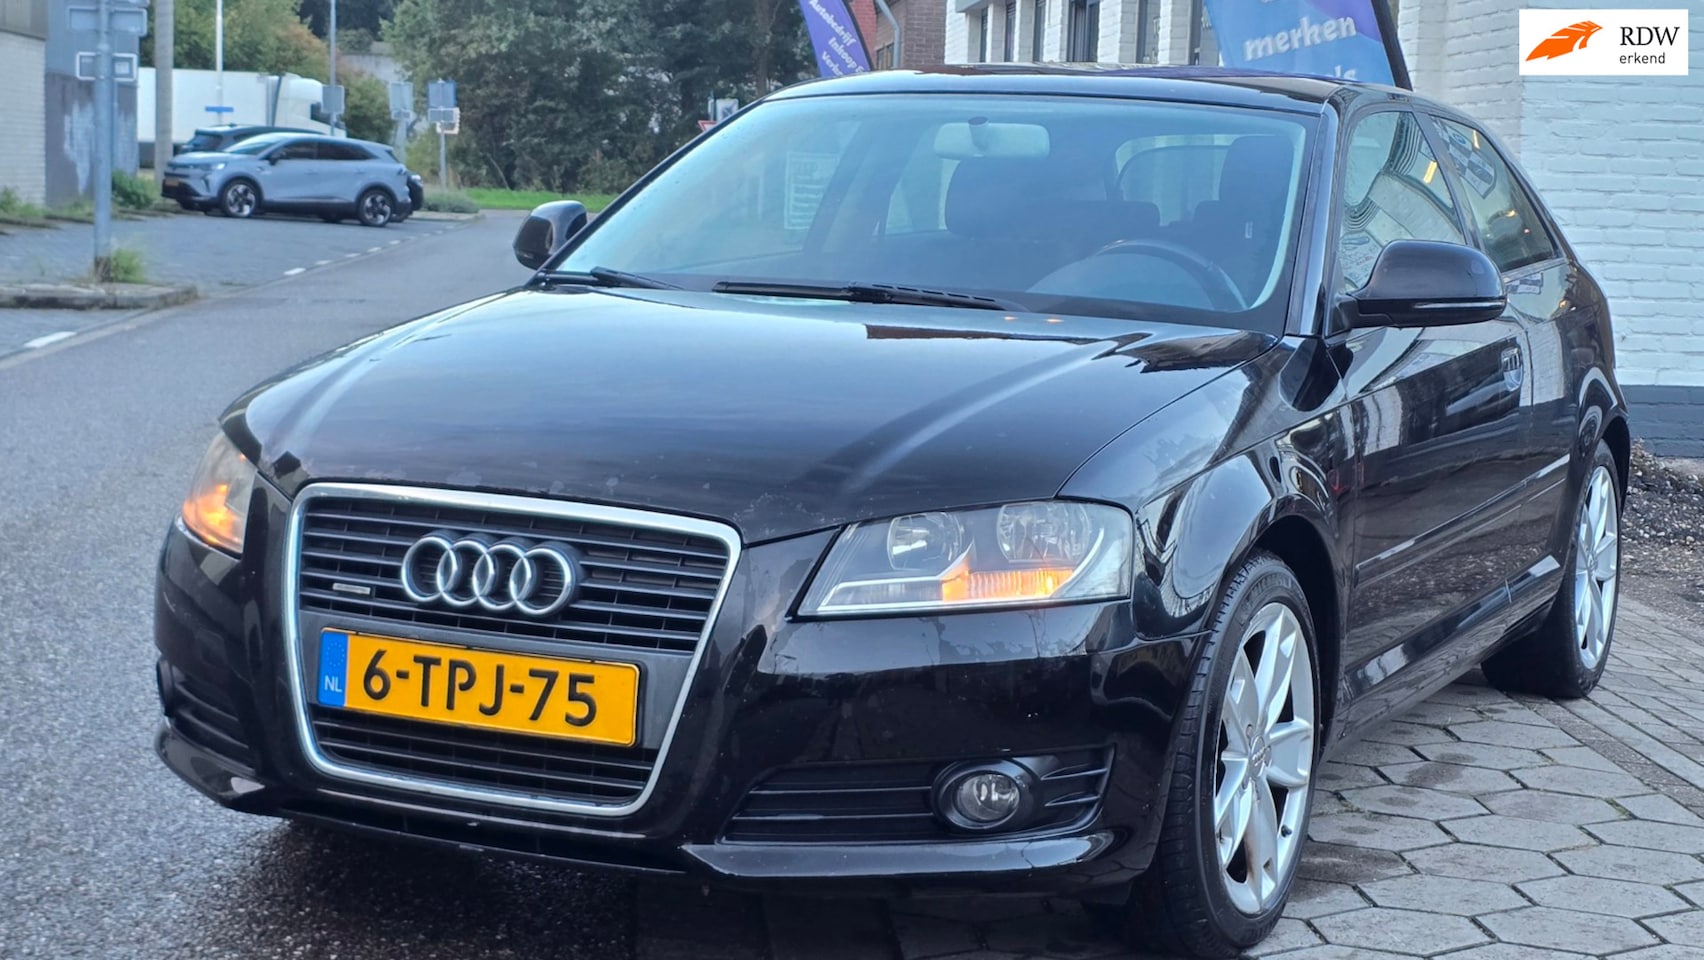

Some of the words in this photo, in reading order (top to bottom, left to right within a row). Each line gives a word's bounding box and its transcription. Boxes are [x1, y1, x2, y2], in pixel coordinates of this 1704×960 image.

[809, 0, 857, 47] Autobedrijf
[1244, 15, 1357, 62] merken
[828, 36, 858, 69] Inkoop
[324, 675, 343, 693] NL
[362, 648, 598, 728] 6-TPJ-75
